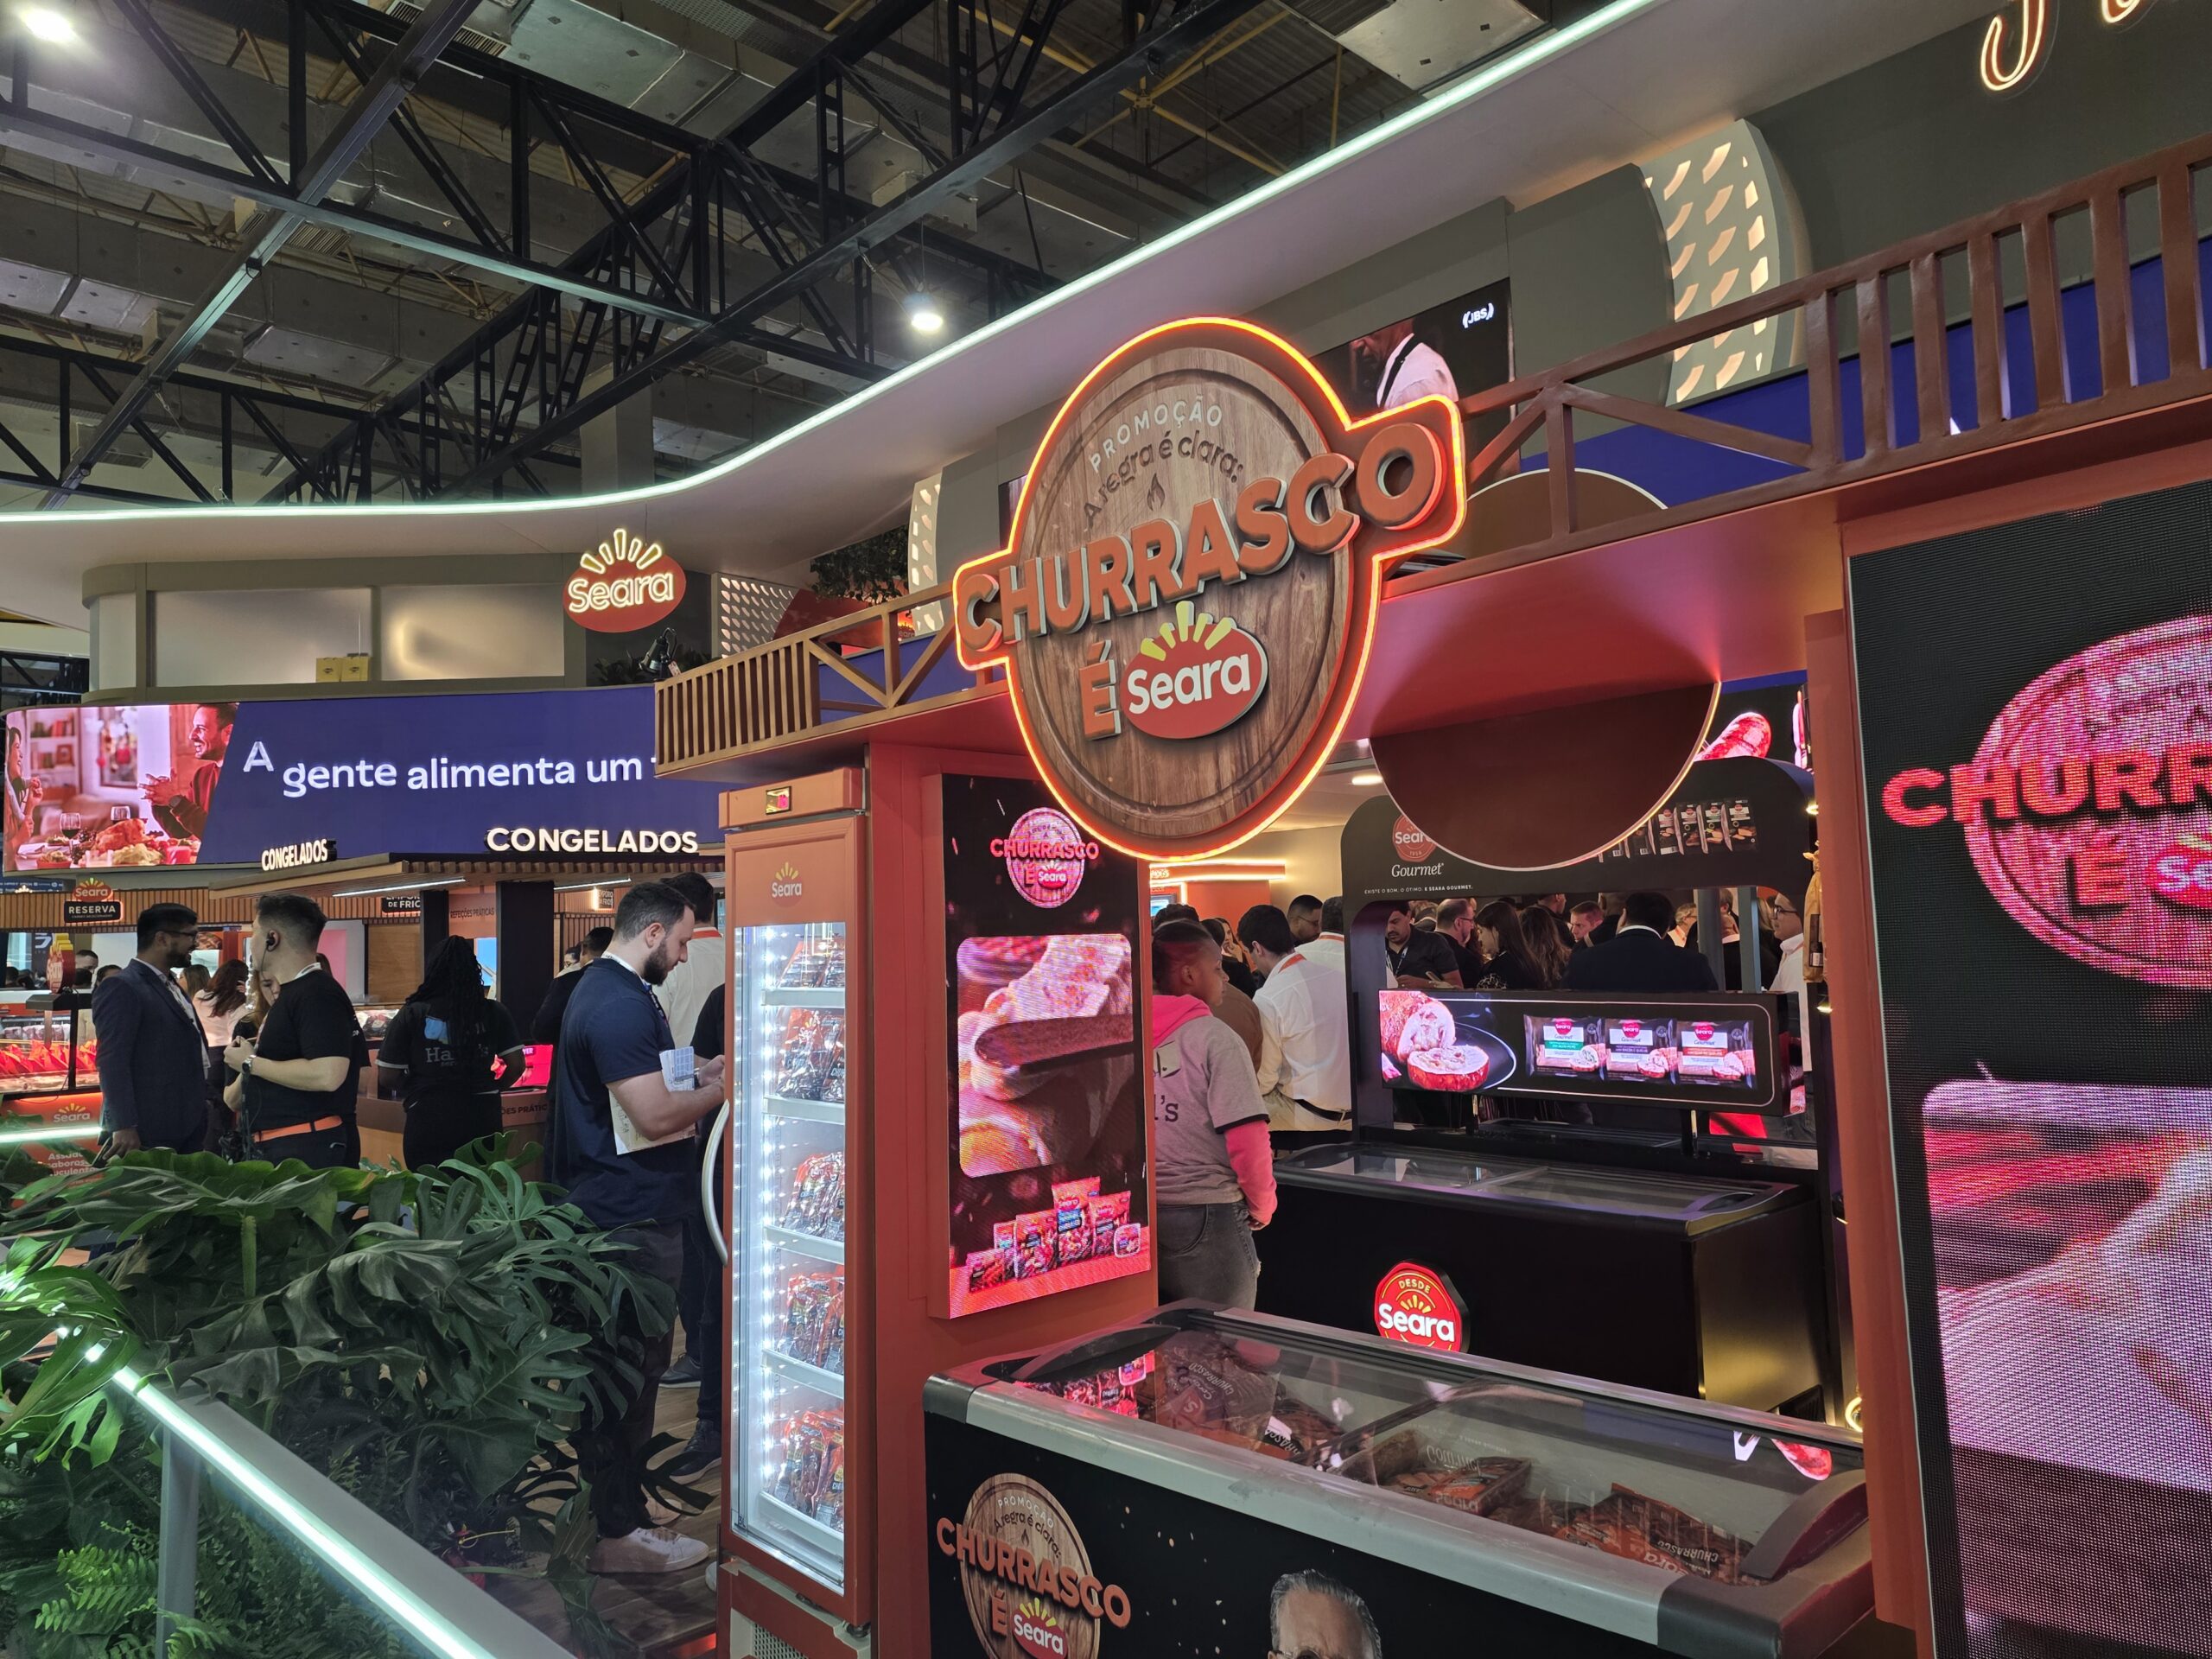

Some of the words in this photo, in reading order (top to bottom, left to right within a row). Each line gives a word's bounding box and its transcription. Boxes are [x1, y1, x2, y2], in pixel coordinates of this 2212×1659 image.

[1090, 395, 1223, 474] PROMOÇÃO
[1084, 501, 1103, 531] A
[1097, 442, 1155, 507] regra
[1158, 430, 1173, 460] é
[1177, 429, 1244, 484] clara:
[957, 422, 1444, 653] CHURRASCO
[568, 571, 674, 613] Seara
[1078, 639, 1122, 741] É
[1127, 652, 1252, 715] Seara
[243, 741, 275, 772] A
[283, 760, 397, 798] gente
[406, 757, 575, 790] alimenta
[586, 756, 643, 783] um
[261, 838, 328, 872] CONGELADOS
[486, 827, 698, 854] CONGELADOS
[990, 838, 1100, 860] CHURRASCO
[1039, 871, 1067, 882] Seara
[1391, 864, 1441, 877] Gourmet
[75, 888, 109, 897] Seara
[772, 882, 802, 898] Seara
[69, 905, 116, 914] RESERVA
[54, 1112, 91, 1122] Seara
[1399, 1279, 1431, 1294] DESDE
[1379, 1302, 1455, 1342] Seara
[1188, 1362, 1235, 1395] CHURRASCO
[997, 1496, 1054, 1529] PROMOÇÃO
[995, 1518, 1001, 1533] A
[1001, 1511, 1027, 1525] regra
[1027, 1514, 1034, 1527] é
[1034, 1522, 1063, 1559] clara:
[1657, 1541, 1719, 1563] CHURRASCO
[936, 1517, 1131, 1629] CHURRASCO
[992, 1588, 1007, 1637] É
[1013, 1613, 1065, 1656] Seara
